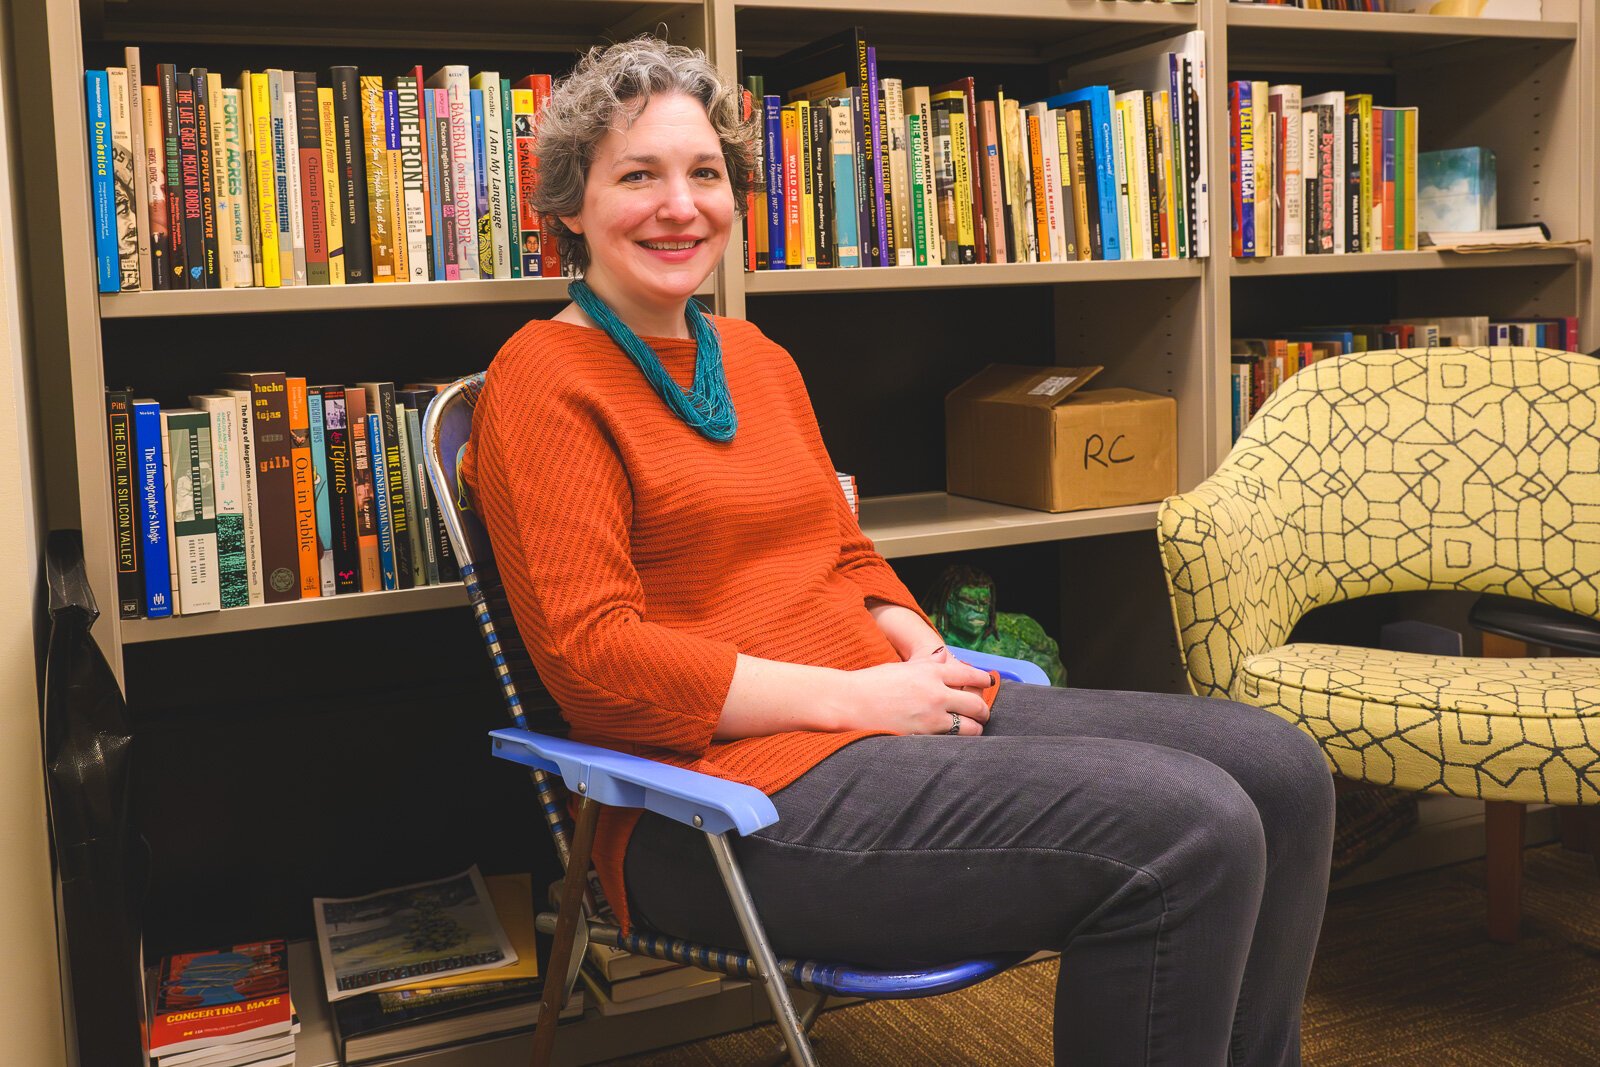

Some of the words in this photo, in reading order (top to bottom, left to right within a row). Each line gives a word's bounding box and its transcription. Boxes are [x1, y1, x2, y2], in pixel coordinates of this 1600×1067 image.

[859, 40, 868, 81] EDWARD
[131, 64, 139, 107] DREAMLAND
[178, 90, 192, 103] THE
[180, 107, 194, 124] LATE
[488, 86, 497, 117] González
[861, 83, 871, 122] SHERIFF
[878, 99, 886, 112] THE
[198, 104, 207, 145] CHICANO
[224, 95, 241, 146] FORTY
[343, 116, 351, 138] LABOR
[440, 121, 450, 145] Chicano
[451, 102, 467, 163] BASEBALL
[879, 114, 887, 142] MANUAL
[912, 119, 921, 135] THE
[921, 103, 930, 152] LOCKDOWN
[96, 122, 107, 176] Doméstica
[166, 137, 177, 156] PURO
[181, 128, 196, 150] GREAT
[258, 116, 267, 154] Chicana
[398, 77, 423, 193] HOMEFRONT
[490, 137, 500, 152] Am
[864, 125, 873, 160] CURTIS
[881, 144, 888, 154] OF
[959, 122, 967, 152] WALLY
[1075, 131, 1083, 139] THE
[1075, 140, 1083, 154] CASE
[326, 148, 335, 173] Frontera
[441, 147, 451, 169] English
[490, 155, 502, 176] My
[913, 137, 923, 185] GOVERNOR
[943, 151, 951, 163] long
[1240, 107, 1255, 197] VIETNAMERICA
[167, 160, 179, 186] BORDER
[183, 155, 198, 186] MEXICAN
[201, 150, 211, 193] POPULAR
[226, 148, 241, 195] ACRES
[262, 160, 271, 198] Without
[308, 157, 318, 197] Chicana
[458, 163, 466, 176] ON
[459, 176, 468, 191] THE
[789, 155, 798, 186] WORLD
[882, 155, 891, 194] DETECTION
[924, 155, 932, 195] AMERICA
[1319, 133, 1334, 230] Eyewitness
[347, 180, 355, 198] CIVIL
[443, 177, 452, 201] Context
[790, 189, 798, 201] ON
[185, 189, 200, 218] BORDER
[233, 204, 241, 223] mark
[278, 176, 289, 232] OBSERVATION
[348, 200, 356, 224] RIGHTS
[454, 191, 471, 244] BORDER
[491, 178, 504, 229] Language
[791, 205, 799, 224] FIRE
[884, 199, 893, 228] JEDEDIAH
[204, 197, 213, 239] CULTURE
[263, 203, 273, 240] Apology
[310, 200, 322, 253] Feminisms
[234, 226, 243, 242] day
[255, 398, 268, 407] en
[310, 399, 322, 424] CHICANA
[114, 422, 126, 443] THE
[241, 418, 249, 435] Maya
[312, 426, 323, 443] WAYS
[332, 431, 341, 444] Las
[115, 444, 127, 472] DEVIL
[144, 447, 155, 462] The
[242, 444, 252, 478] Morganton
[260, 456, 290, 473] gilb
[387, 445, 398, 467] TIME
[1084, 434, 1135, 470] RC
[117, 475, 128, 485] IN
[295, 457, 309, 486] Out
[329, 441, 349, 494] Tejanas
[374, 454, 385, 494] IMAGINED
[389, 471, 401, 492] FULL
[144, 462, 159, 518] Ethnographer's
[297, 490, 311, 503] in
[391, 495, 403, 505] OF
[118, 488, 130, 528] SILICON
[247, 503, 255, 529] Community
[394, 509, 406, 533] TRIAL
[148, 520, 160, 544] Magic
[299, 510, 313, 552] Public
[378, 495, 390, 553] COMMUNITIES
[120, 530, 131, 566] VALLEY
[167, 1005, 242, 1023] CONCERTINA
[246, 997, 280, 1010] MAZE
